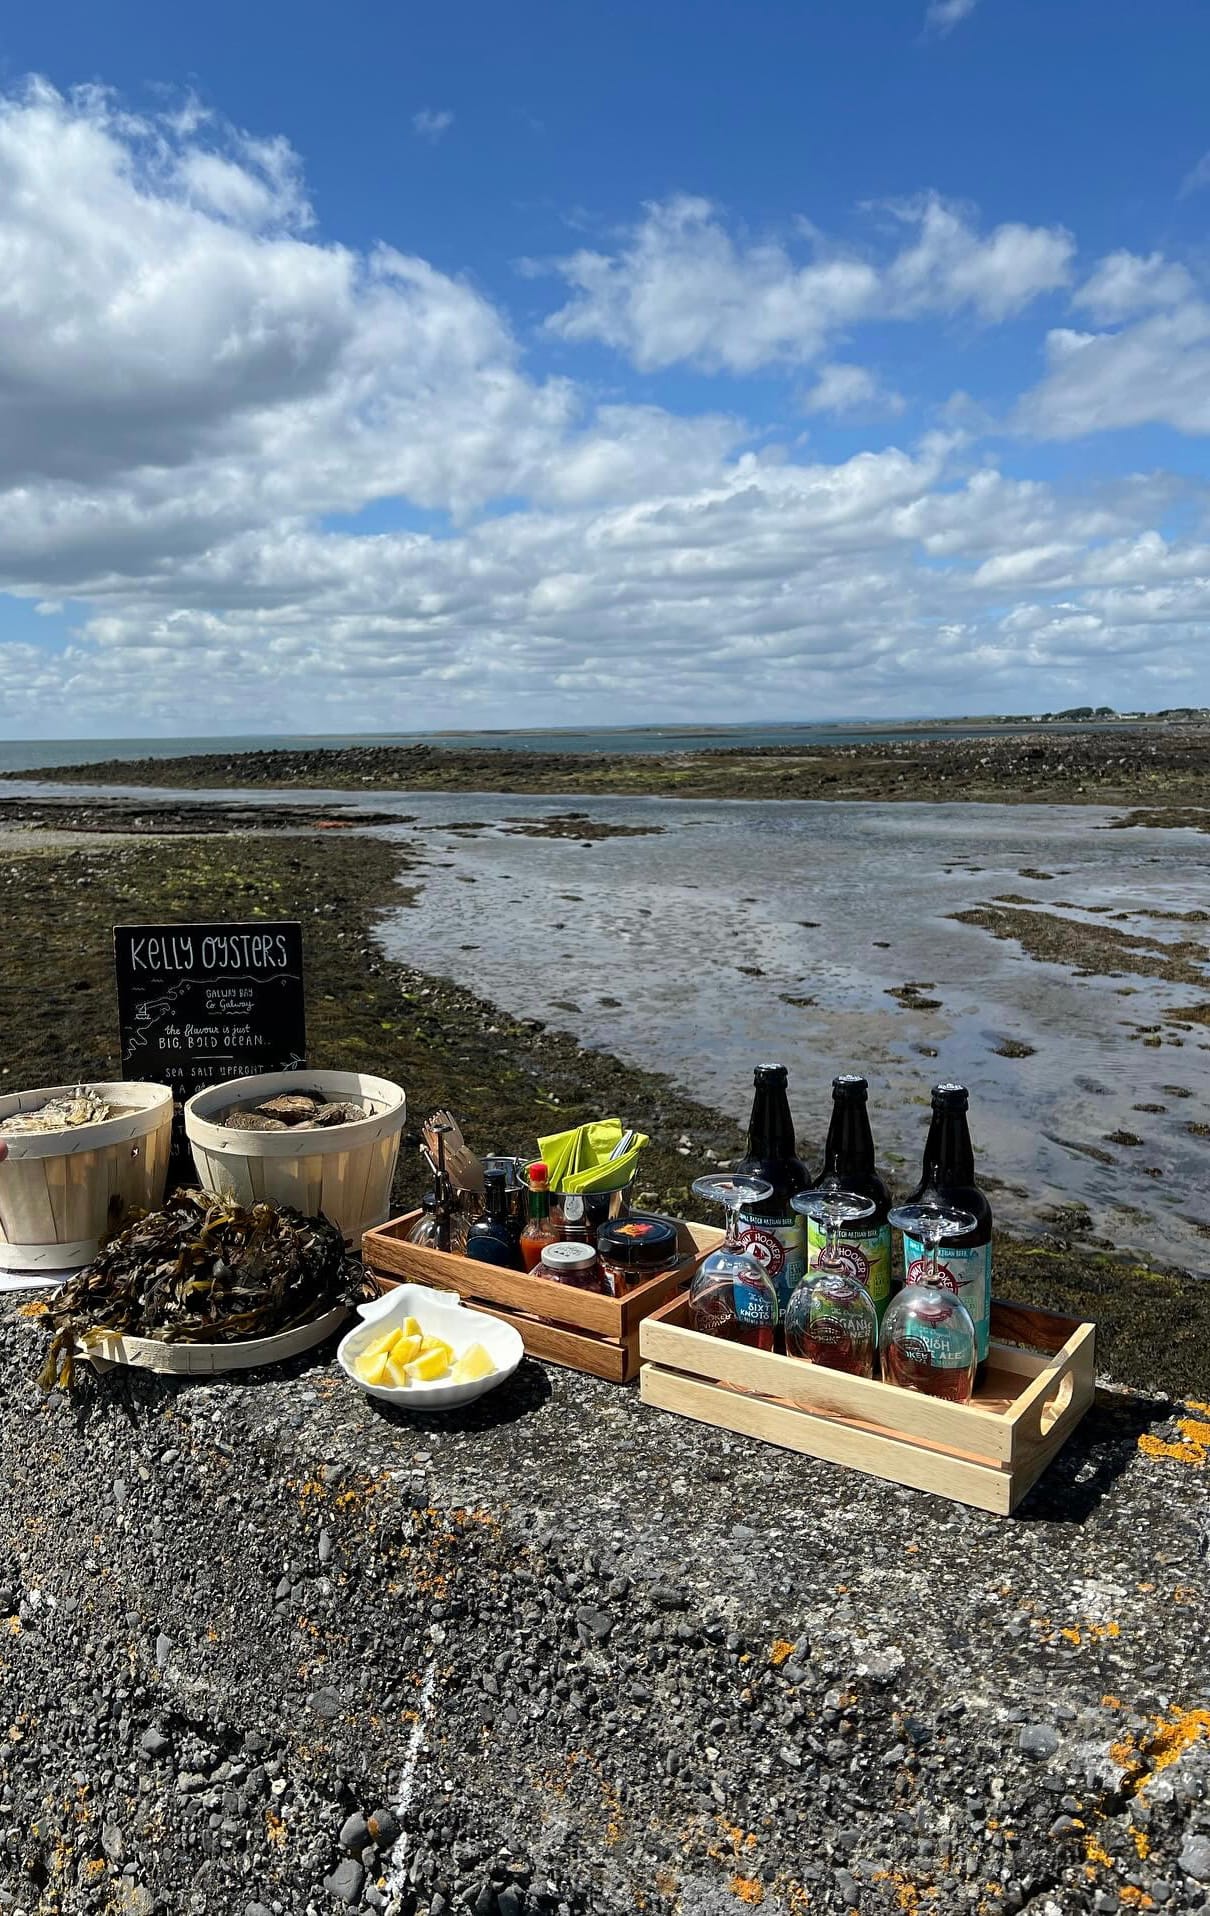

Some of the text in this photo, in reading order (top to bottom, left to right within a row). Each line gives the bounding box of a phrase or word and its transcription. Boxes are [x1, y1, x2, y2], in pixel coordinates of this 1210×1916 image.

[131, 935, 288, 970] KELLY OYSTERS
[206, 988, 237, 999] GALWAY
[164, 1023, 251, 1037] the flavour is just
[187, 1036, 219, 1048] BOLD
[191, 1066, 214, 1077] SALT
[755, 1232, 781, 1260] HOOKER
[839, 1247, 867, 1273] HOOKER
[740, 1308, 770, 1321] KNOTS
[939, 1350, 962, 1360] ALE
